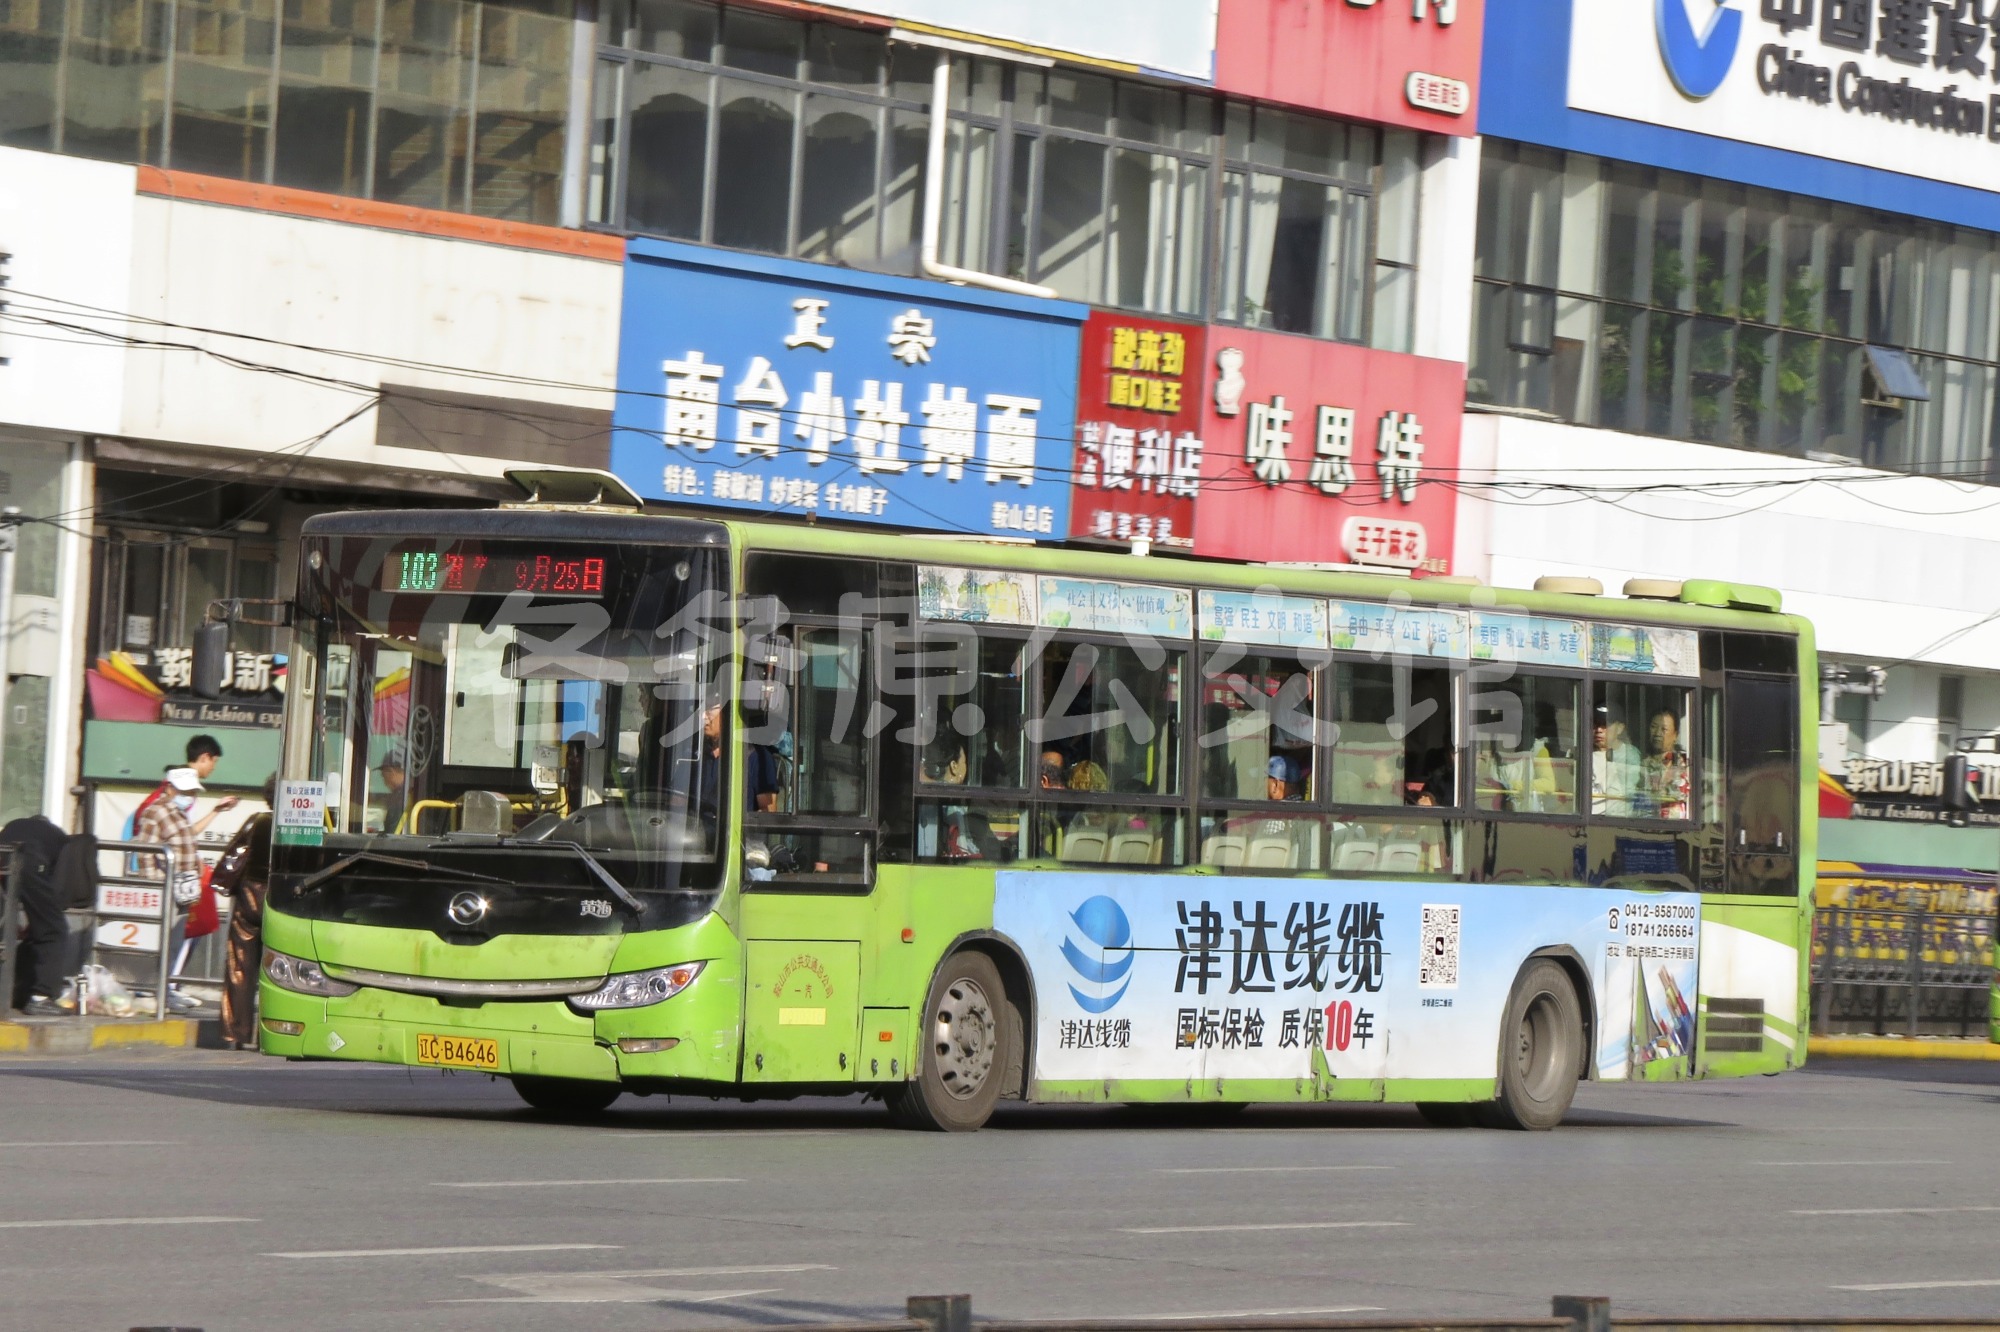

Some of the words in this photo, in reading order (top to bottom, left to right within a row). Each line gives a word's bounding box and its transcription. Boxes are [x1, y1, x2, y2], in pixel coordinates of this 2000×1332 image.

[1757, 44, 1831, 106] China
[1837, 61, 1985, 137] Construction
[784, 298, 937, 364] 正宗
[1101, 422, 1204, 497] 便利店
[1246, 395, 1425, 505] 味思特
[1356, 526, 1419, 560] 王子麻花
[400, 552, 438, 590] 103
[515, 556, 604, 591] 9月25日
[1241, 608, 1260, 630] 民主
[1267, 610, 1287, 631] 文明
[1402, 620, 1421, 641] 公正
[154, 647, 273, 692] 鞍新
[1624, 903, 1695, 919] 0412-8587000
[121, 923, 140, 946] 2
[1174, 900, 1385, 995] 津达线缆
[1624, 923, 1694, 938] 18741266664
[1059, 1018, 1132, 1049] 津达线缆
[1175, 1006, 1266, 1050] 国标保检
[1278, 1000, 1375, 1052] 质保10年
